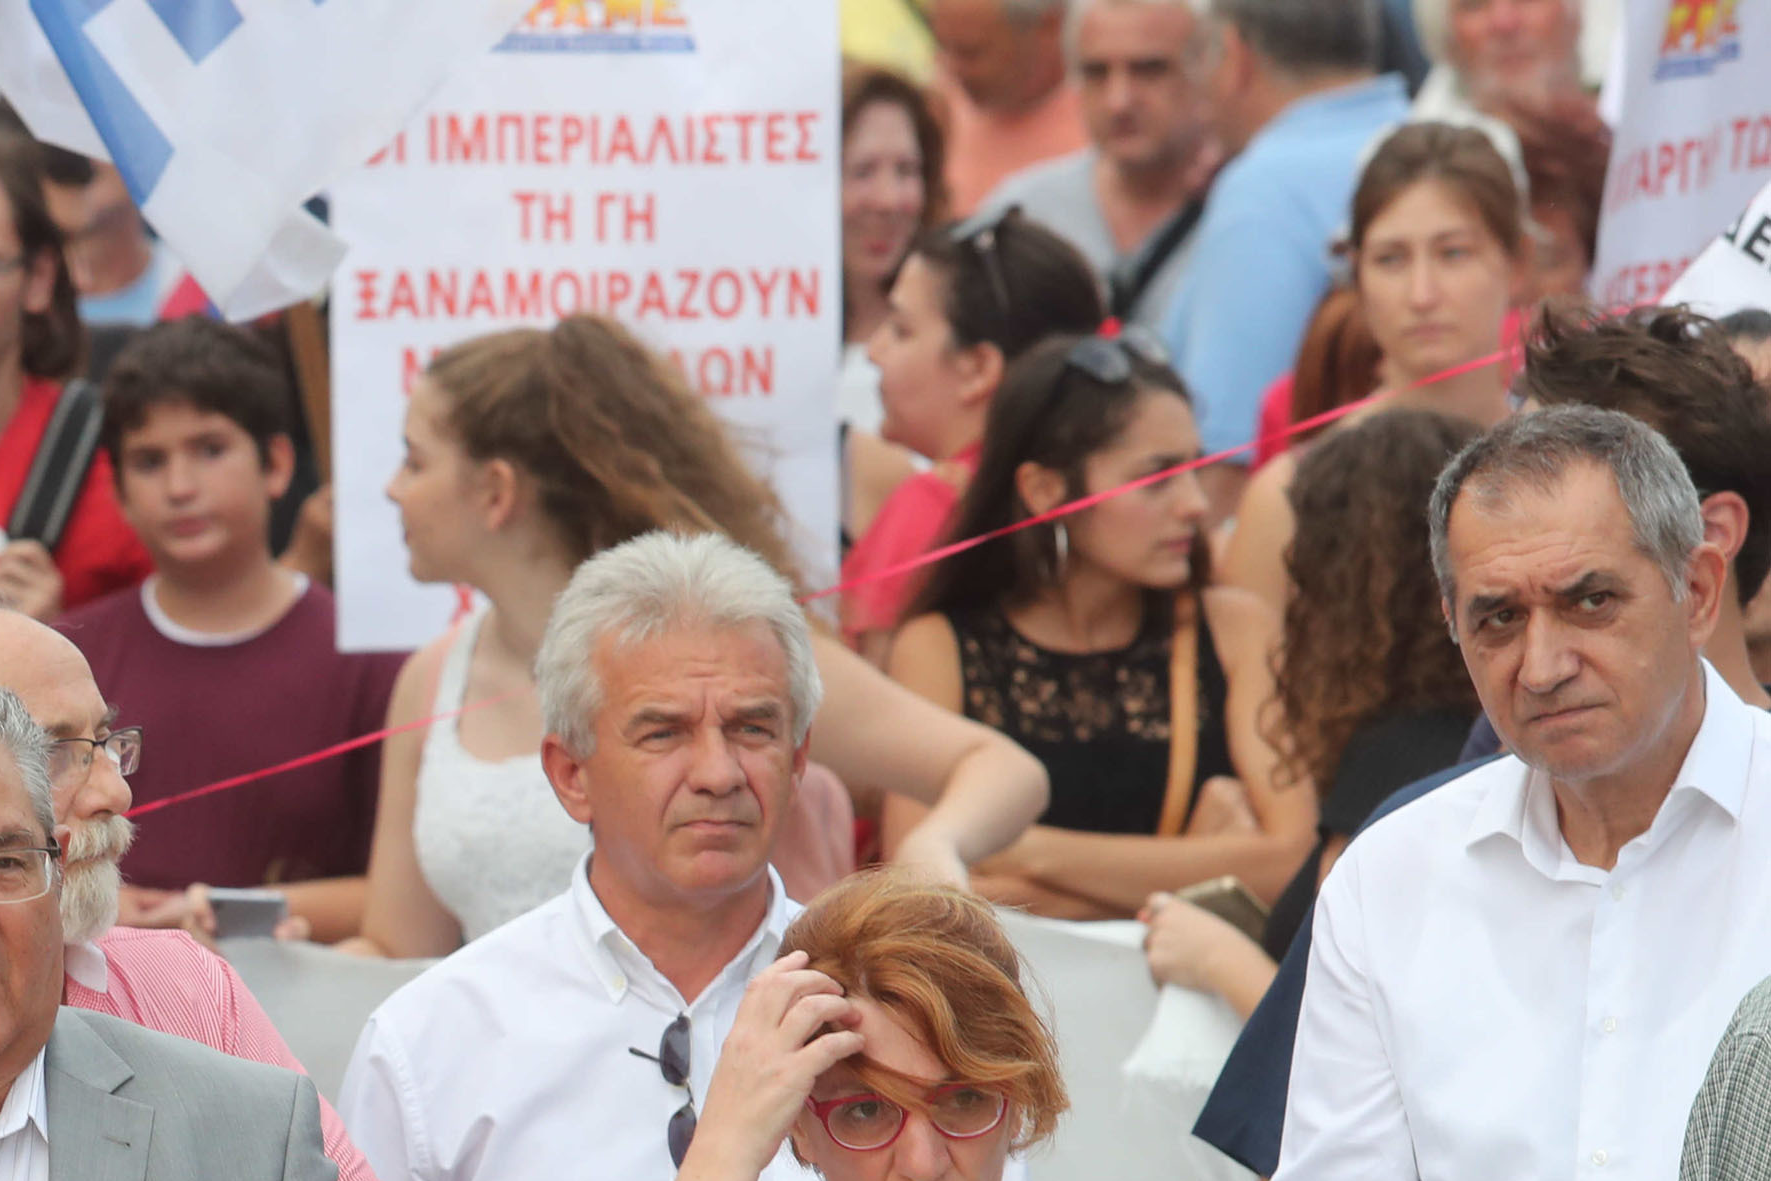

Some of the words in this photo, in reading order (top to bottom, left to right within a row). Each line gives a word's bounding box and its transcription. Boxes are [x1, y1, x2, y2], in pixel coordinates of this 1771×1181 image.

[428, 113, 820, 167] ΙΜΠΕΡΙΑΛΙΣΤΕΣ
[512, 194, 573, 242] ΤΗ
[596, 194, 656, 242] ΓΗ
[354, 269, 821, 320] ΞΑΝΑΜΟΙΡΑΖΟΥΝ
